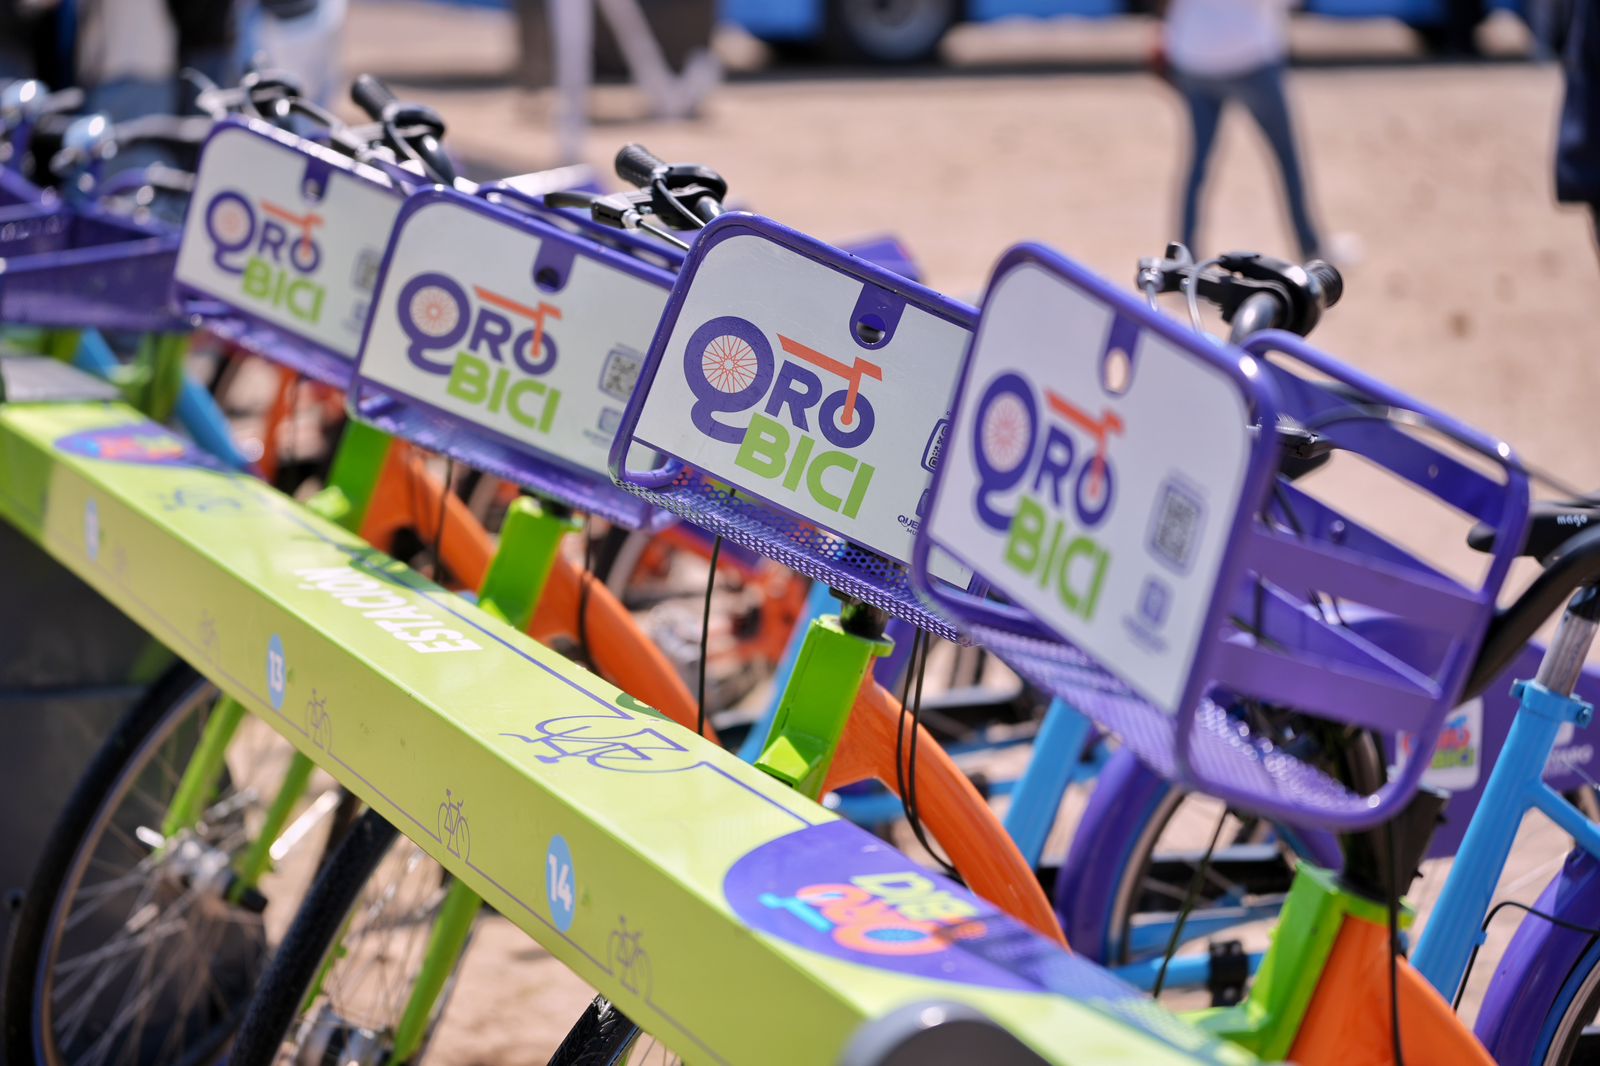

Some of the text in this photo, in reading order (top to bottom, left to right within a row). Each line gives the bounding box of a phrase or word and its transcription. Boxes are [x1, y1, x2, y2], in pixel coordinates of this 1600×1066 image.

[205, 190, 321, 275] QRO
[241, 258, 327, 324] BICI
[397, 272, 557, 376] QRO
[447, 351, 561, 434] BICI
[683, 315, 876, 448] QRO
[734, 413, 875, 520] BICI
[973, 373, 1116, 534] QRO
[1004, 495, 1110, 622] BICI
[293, 568, 483, 653] ESTACIÓN
[269, 649, 283, 692] 13
[549, 853, 572, 912] 14
